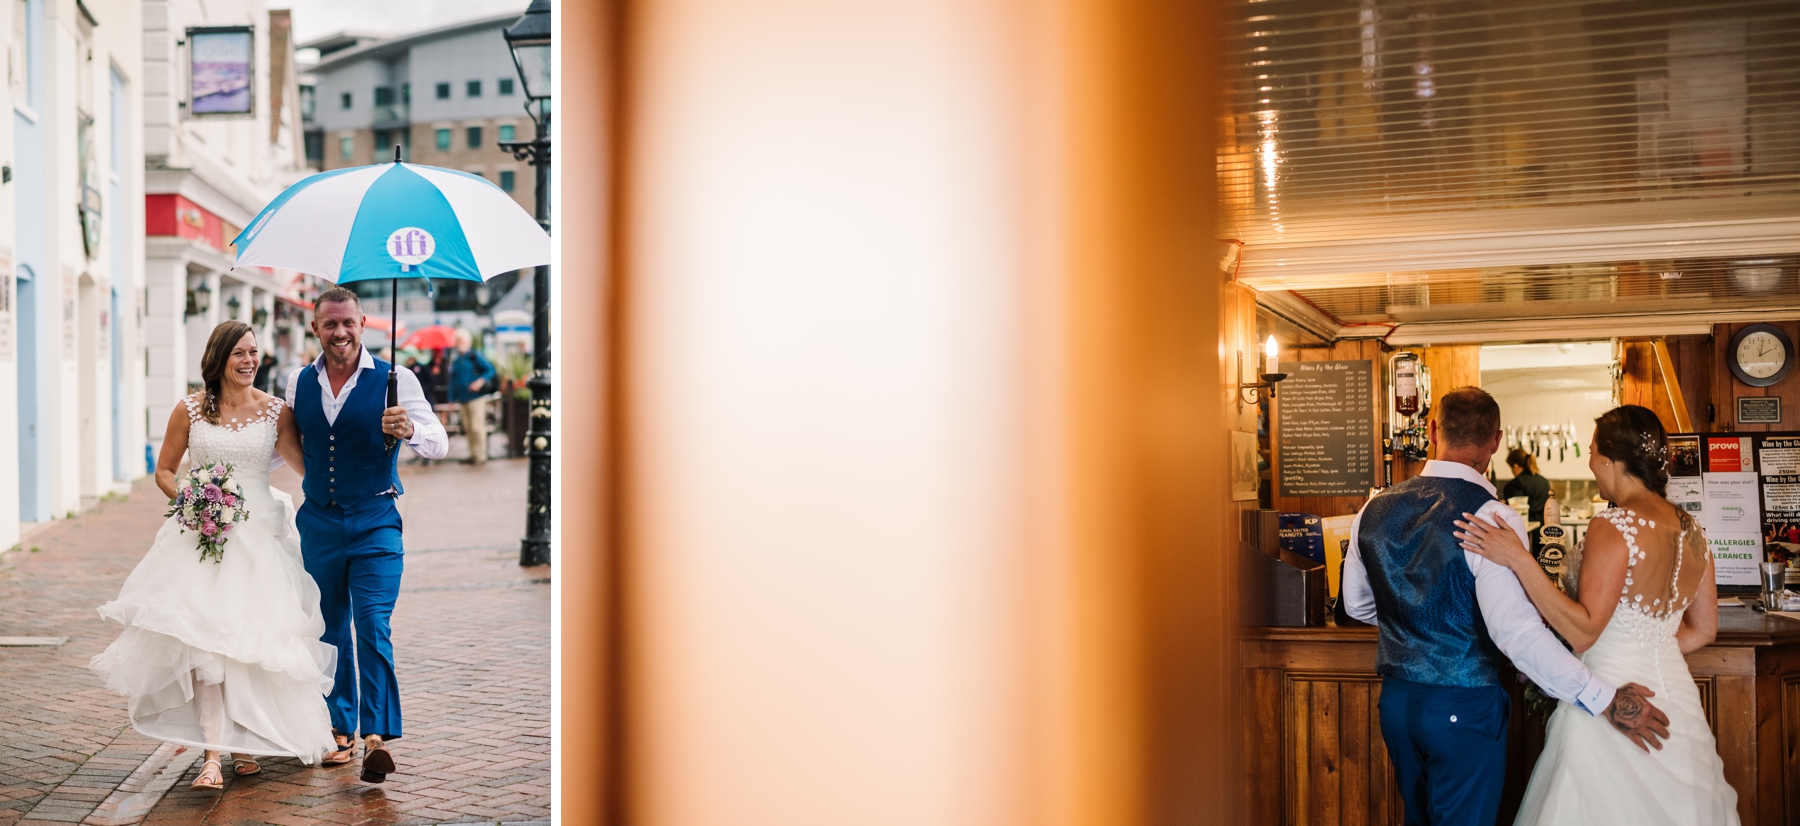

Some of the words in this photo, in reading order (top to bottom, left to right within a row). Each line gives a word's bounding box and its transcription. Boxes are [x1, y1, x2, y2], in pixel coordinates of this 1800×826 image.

[392, 229, 429, 256] ifi
[1316, 364, 1323, 372] By
[1710, 443, 1739, 451] prove
[1775, 441, 1782, 449] by
[1780, 476, 1786, 484] by
[1333, 528, 1350, 537] NUT
